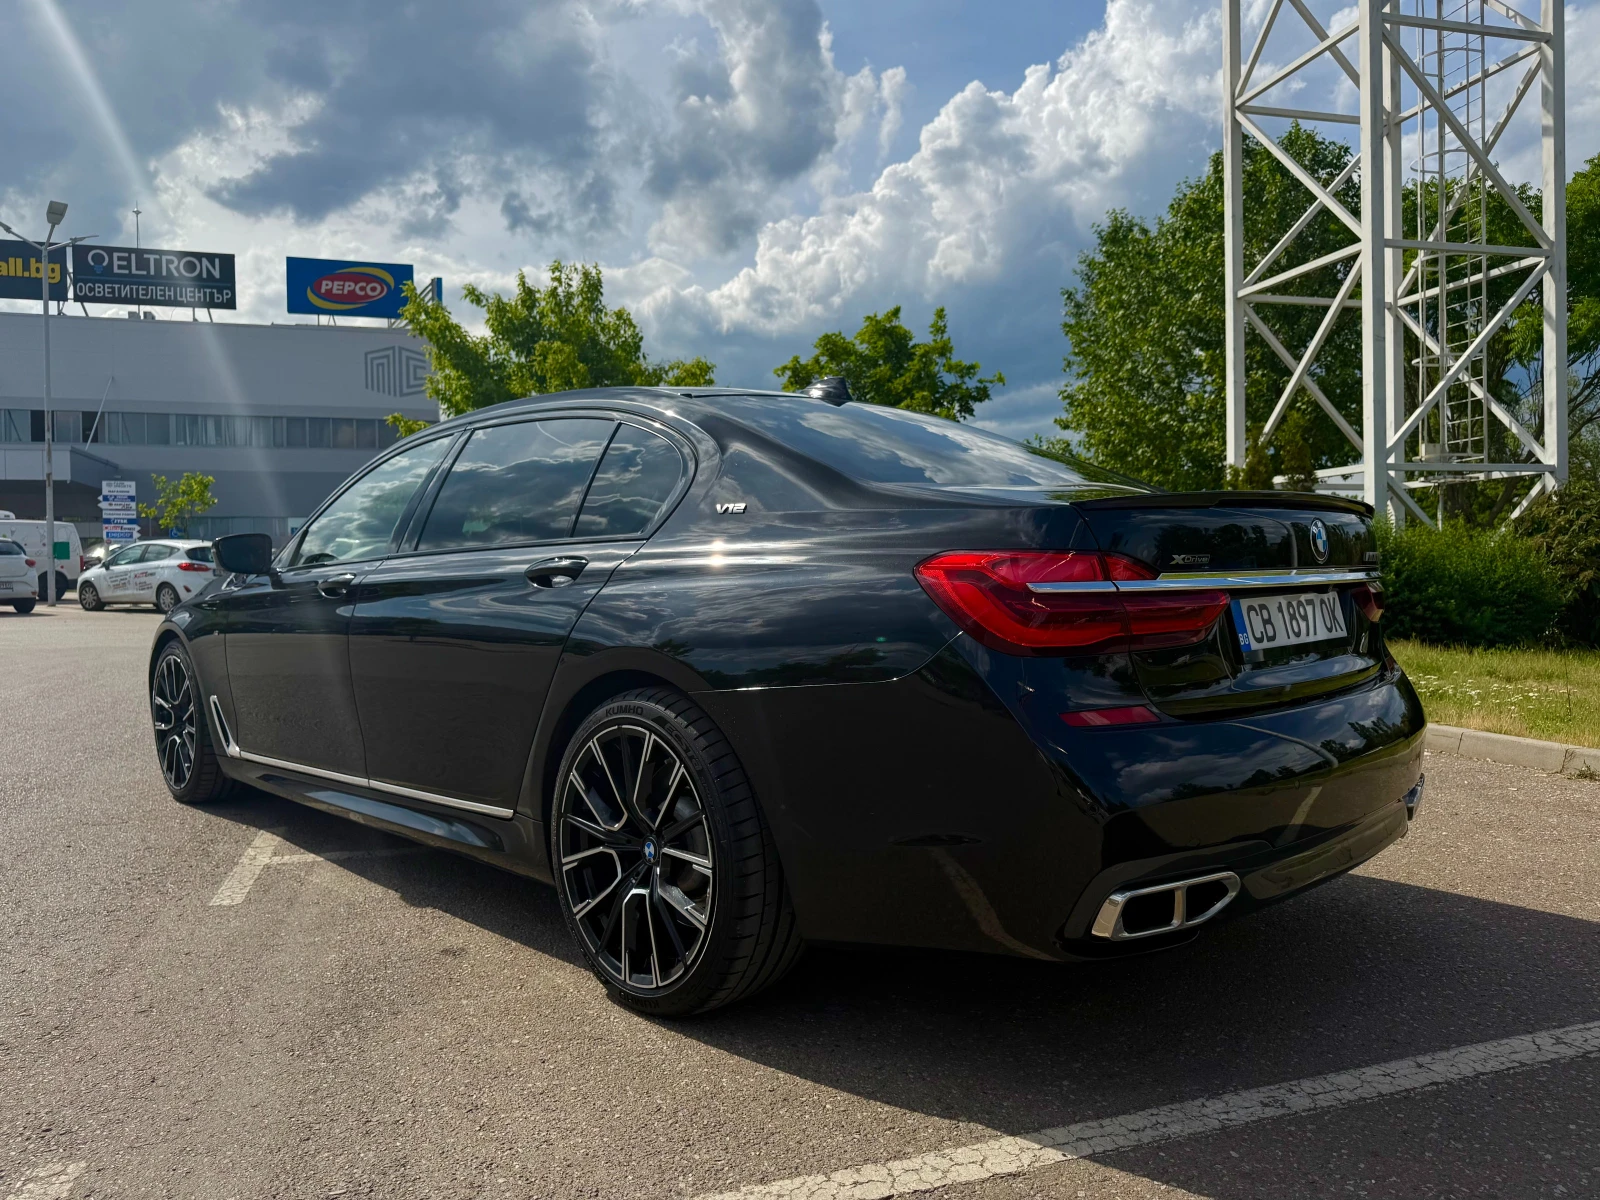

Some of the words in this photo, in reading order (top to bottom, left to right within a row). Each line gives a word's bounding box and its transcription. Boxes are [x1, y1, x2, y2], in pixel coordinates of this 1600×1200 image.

[112, 252, 220, 279] ELTRON
[76, 282, 174, 300] ОСВЕТИТЕЛЕН
[177, 286, 232, 303] ЦЕНТЪР
[321, 280, 382, 296] PEPCO
[716, 502, 747, 514] V12
[1277, 598, 1317, 639] 1897
[1238, 633, 1249, 645] BG
[605, 704, 644, 717] KUMHO
